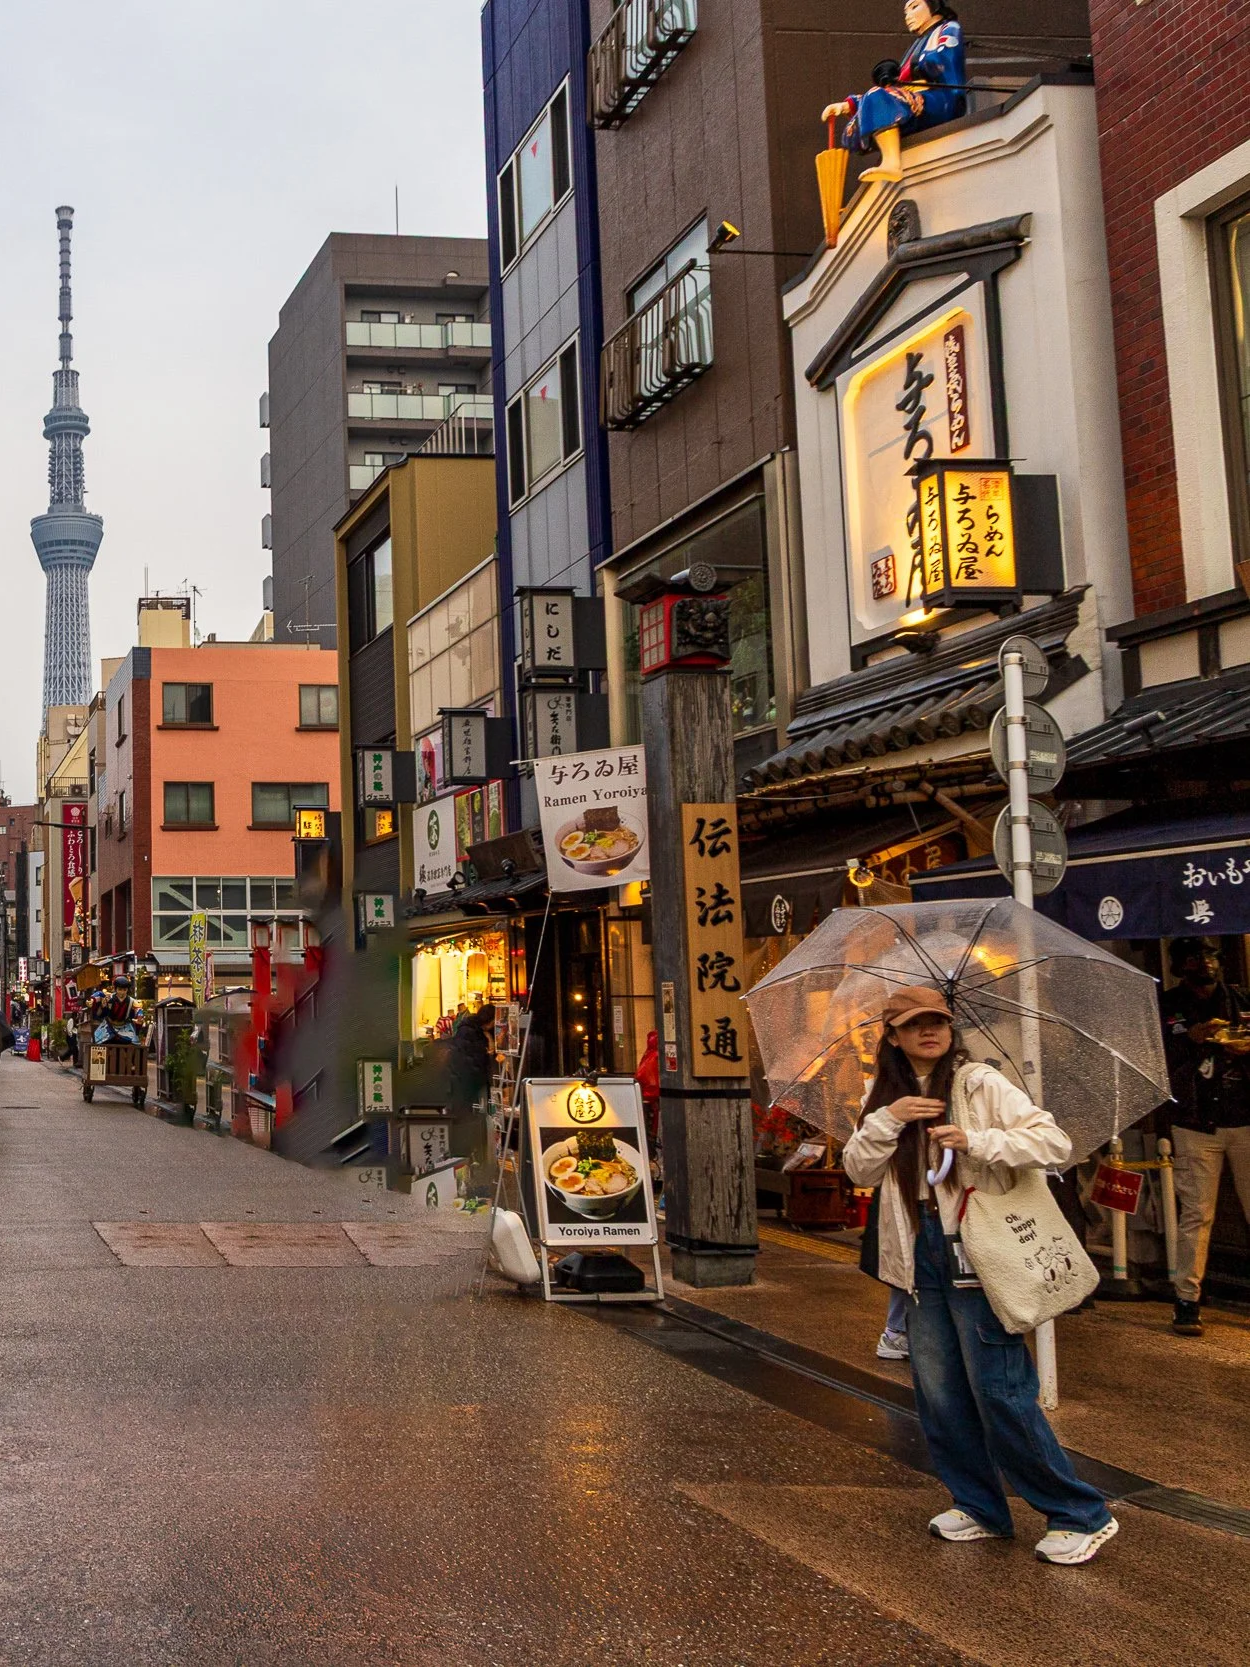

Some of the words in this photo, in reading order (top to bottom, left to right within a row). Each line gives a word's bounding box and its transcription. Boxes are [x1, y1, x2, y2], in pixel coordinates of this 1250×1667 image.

[545, 602, 562, 661] にしだ
[548, 754, 639, 786] 与ろゐ屋
[366, 793, 391, 801] ヴェニス
[544, 794, 587, 808] Ramen
[592, 785, 647, 801] Yoroiya
[67, 830, 76, 878] ふわとろ食感
[689, 817, 743, 1063] 伝法院通
[558, 1226, 600, 1238] Yoroiya
[603, 1226, 640, 1236] Ramen
[1011, 1216, 1037, 1235] happy
[1018, 1231, 1038, 1245] day!
